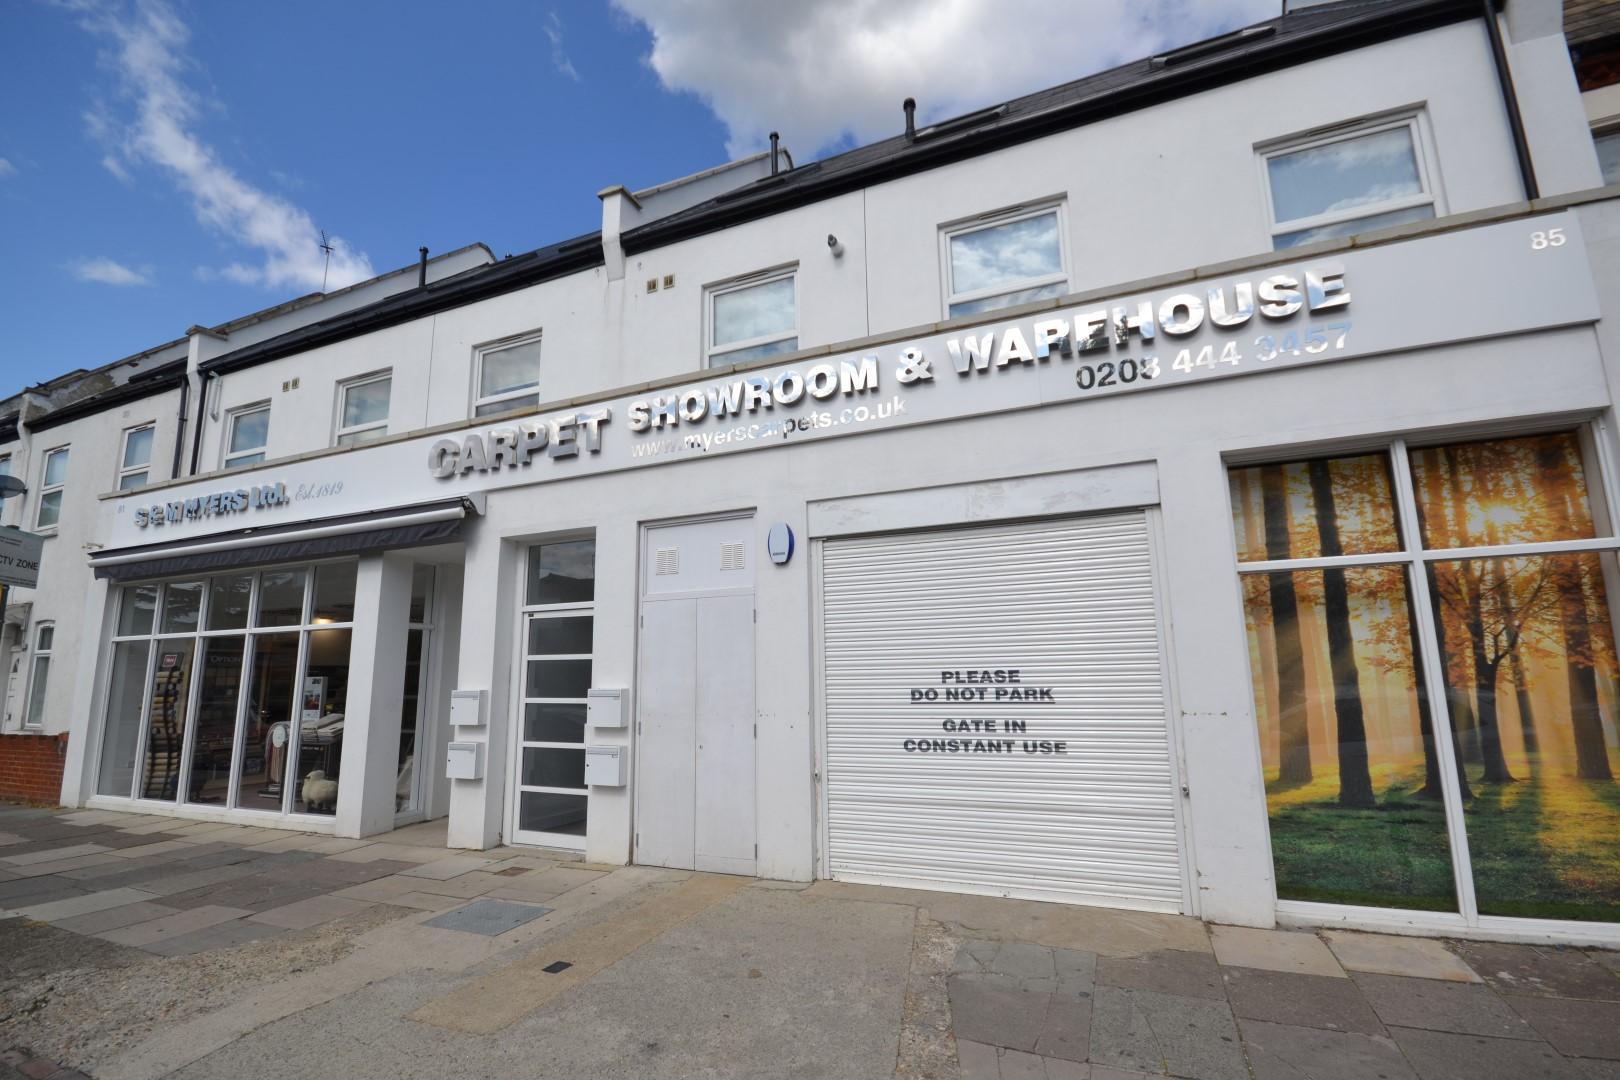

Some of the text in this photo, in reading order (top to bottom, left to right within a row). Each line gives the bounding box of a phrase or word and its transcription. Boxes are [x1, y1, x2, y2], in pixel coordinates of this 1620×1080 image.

[1530, 228, 1566, 250] 85
[1076, 321, 1353, 390] 0208 444 3457
[428, 263, 1352, 480] CARPET SHOWROOM & WAREHOUSE
[631, 395, 908, 459] www.myerscarpets.co.uk
[184, 489, 249, 520] MYERS
[16, 558, 39, 571] ZONE
[941, 669, 1021, 684] PLEASE
[910, 687, 1054, 701] DO NOT PARK
[942, 718, 1027, 734] GATE IN
[903, 738, 1068, 755] CONSTANT USE
